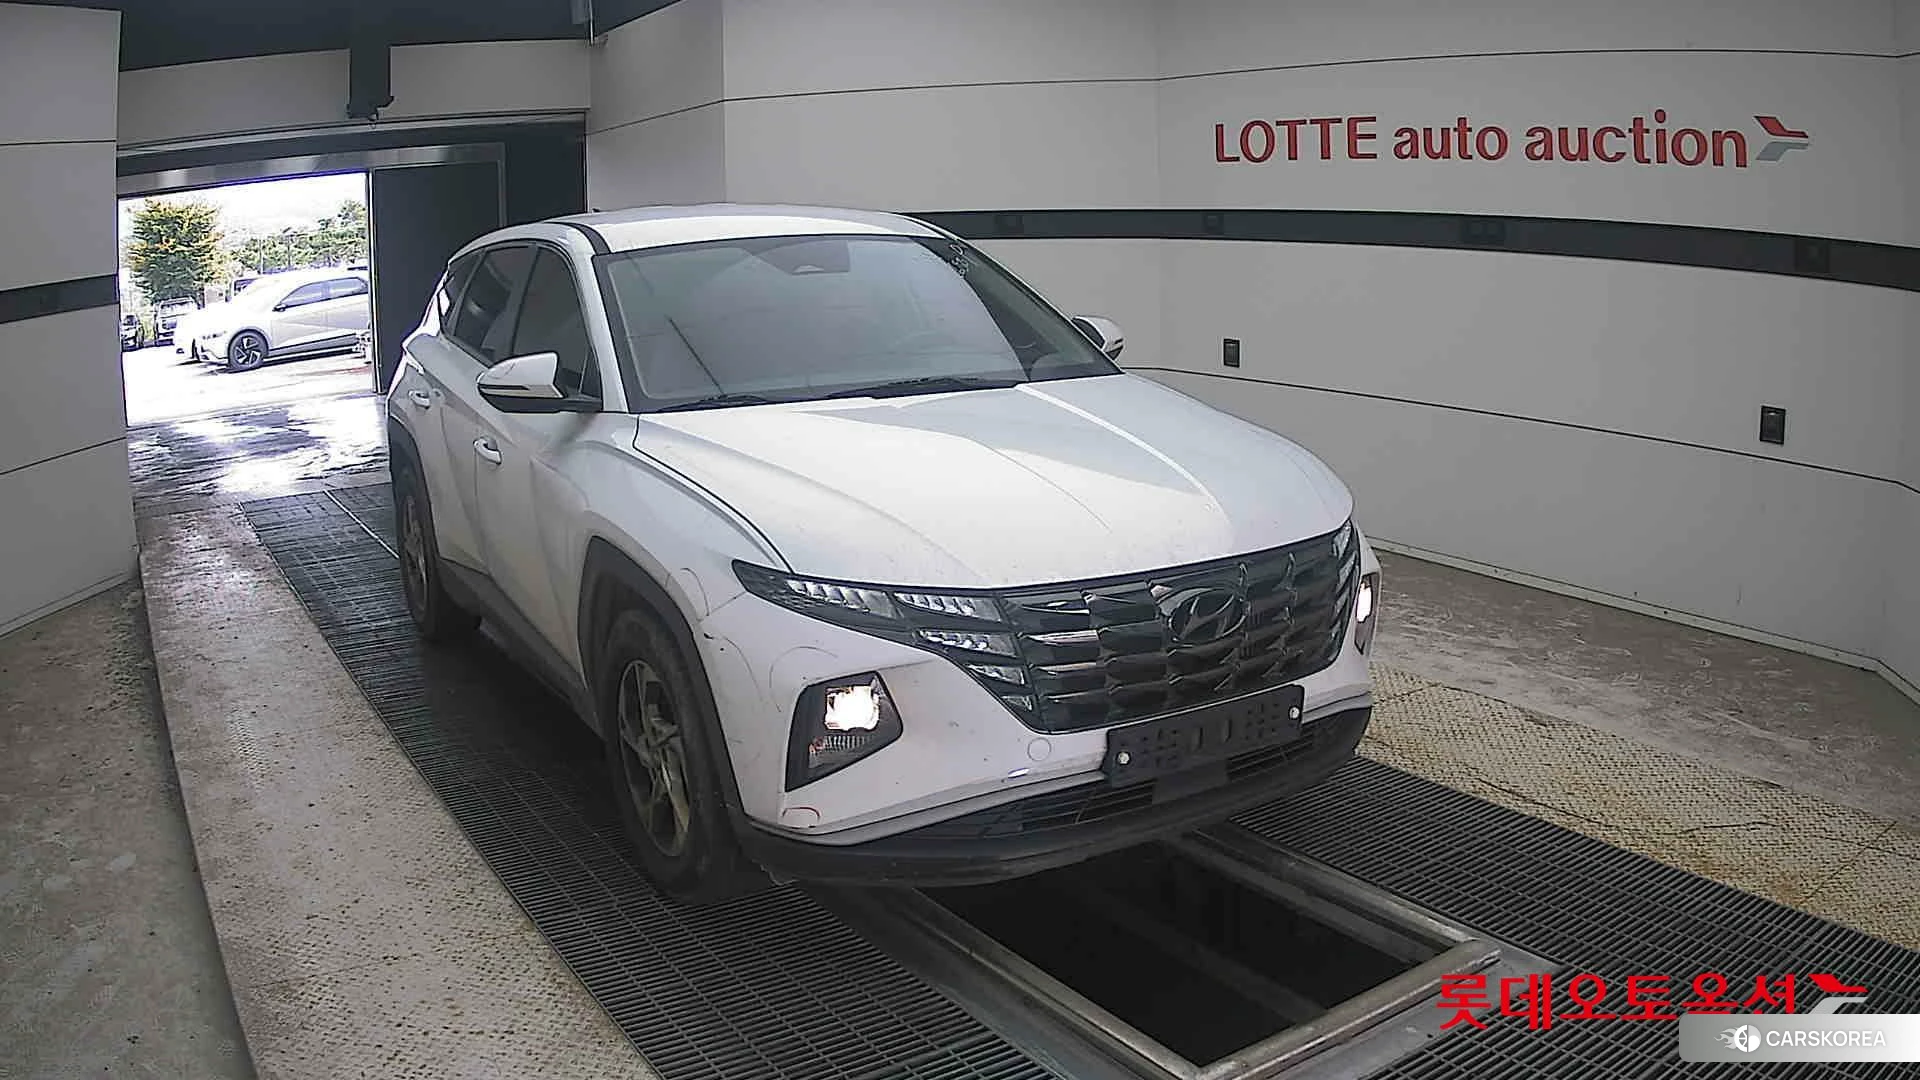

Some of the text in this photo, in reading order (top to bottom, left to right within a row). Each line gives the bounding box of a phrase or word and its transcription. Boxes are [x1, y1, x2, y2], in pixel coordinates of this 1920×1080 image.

[1215, 109, 1748, 168] LOTTE auto auction
